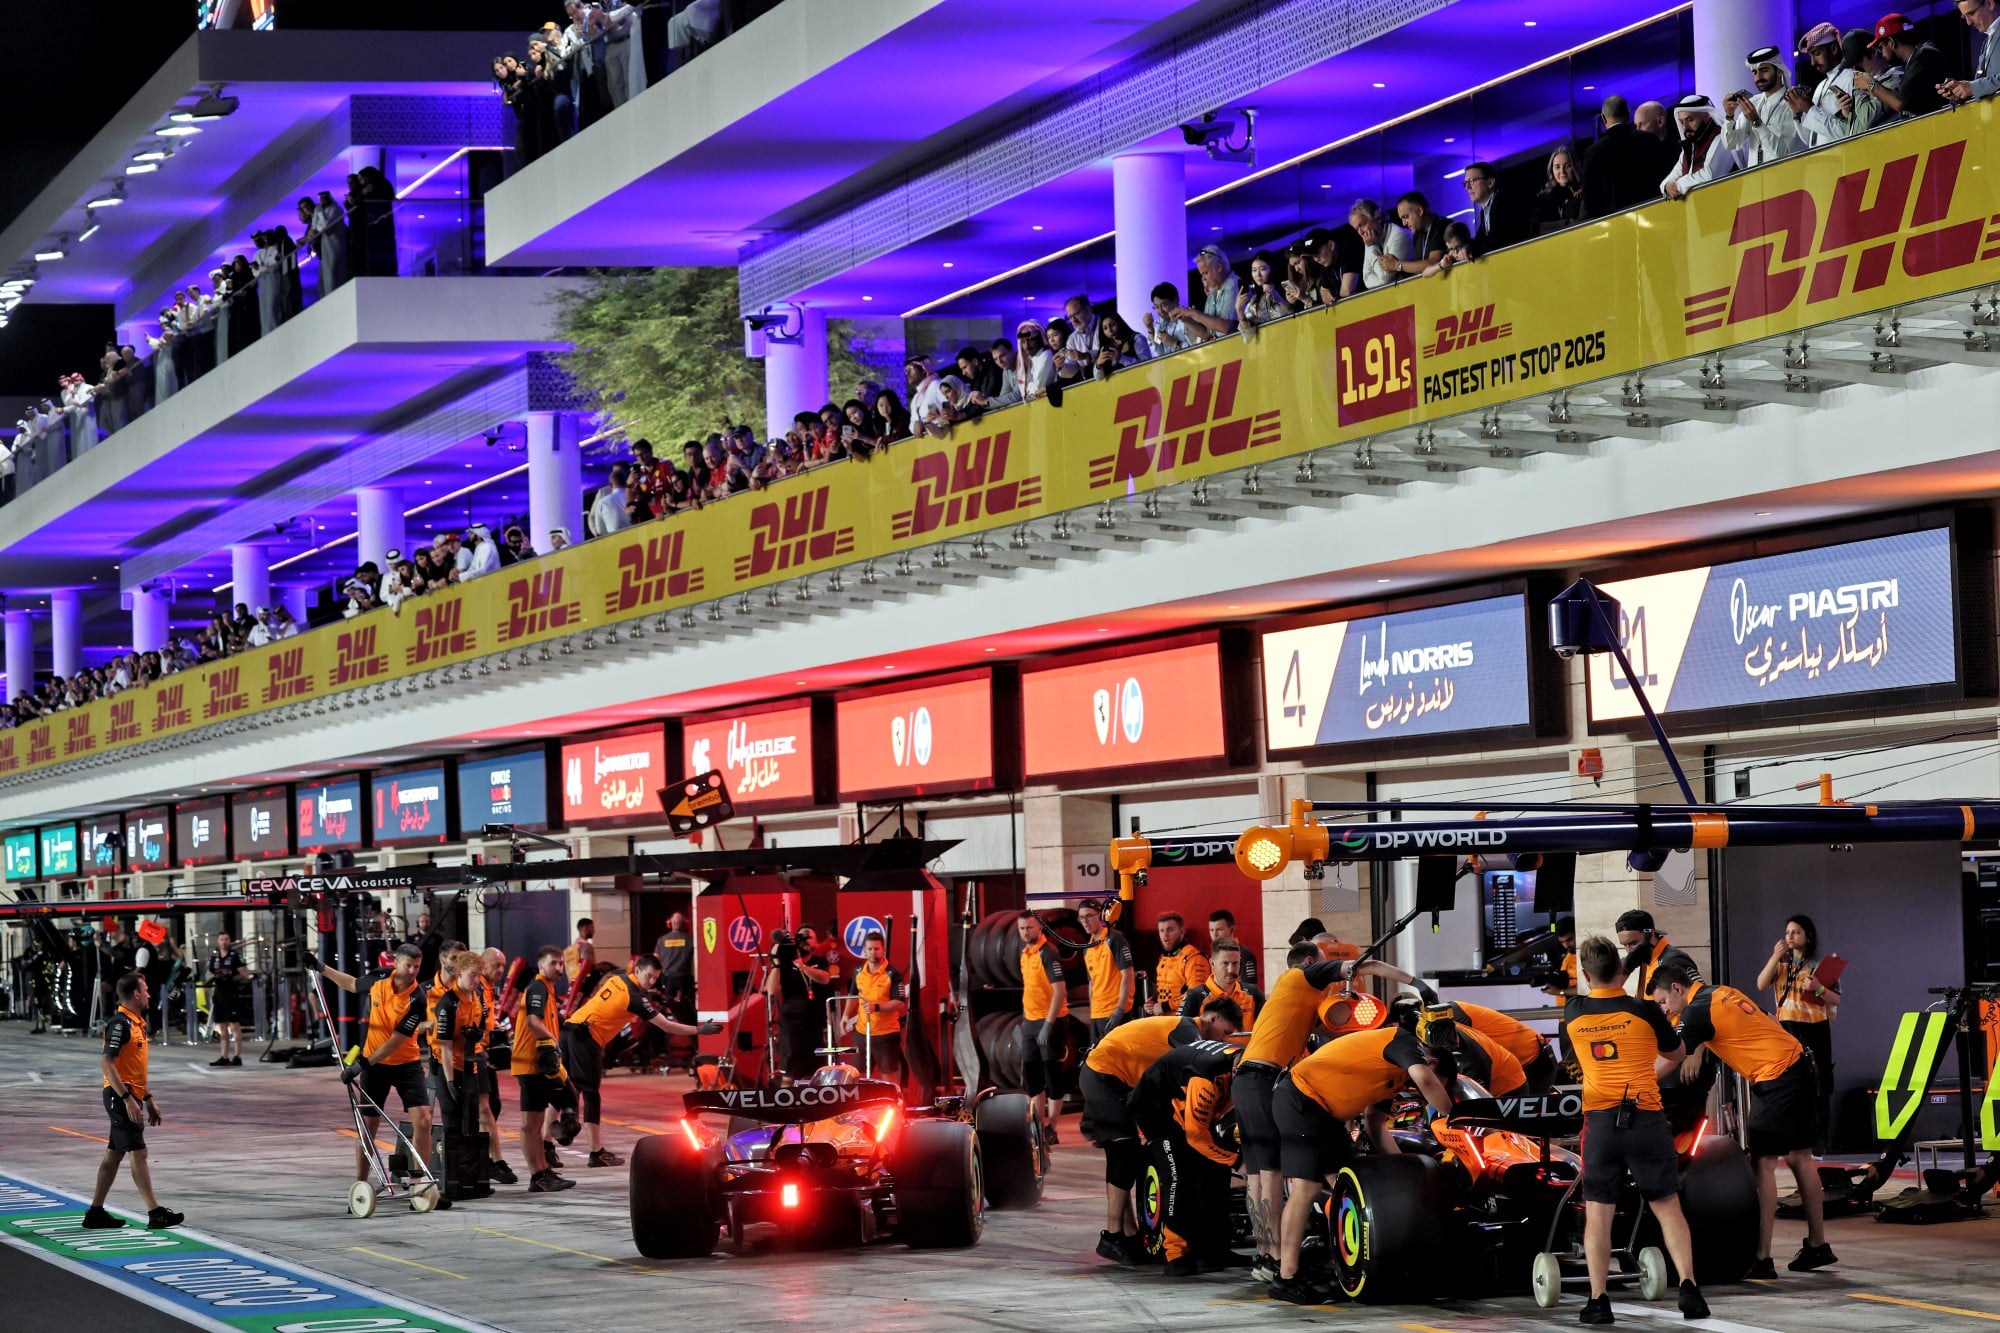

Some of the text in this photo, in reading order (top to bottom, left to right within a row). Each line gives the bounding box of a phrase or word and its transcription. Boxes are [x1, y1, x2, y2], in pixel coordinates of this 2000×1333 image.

[1728, 140, 1985, 324] DHL
[1435, 303, 1500, 356] DHL
[1341, 333, 1411, 405] 1.91s
[1424, 331, 1606, 404] FASTEST PIT STOP 2025
[1114, 359, 1252, 483] DHL
[911, 431, 1020, 536] DHL
[750, 485, 837, 577] DHL
[618, 530, 690, 611] DHL
[509, 567, 569, 640] DHL
[1731, 577, 1899, 645] Oscar PIASTRI
[334, 625, 382, 684] DHL
[412, 599, 467, 663] DHL
[267, 647, 307, 702] DHL
[1392, 642, 1474, 675] NORRIS
[208, 668, 242, 718] DHL
[1283, 650, 1306, 727] 4
[567, 758, 582, 805] 44
[1193, 841, 1222, 857] DP
[1375, 829, 1507, 849] DP WORLD
[355, 877, 413, 888] LOGISTICS
[1077, 863, 1100, 877] 10
[732, 915, 762, 953] hp
[1577, 1022, 1626, 1033] McLaren
[719, 1086, 860, 1108] VELO.COM
[1168, 1183, 1178, 1216] NUTRITION
[122, 1257, 338, 1308] aramco
